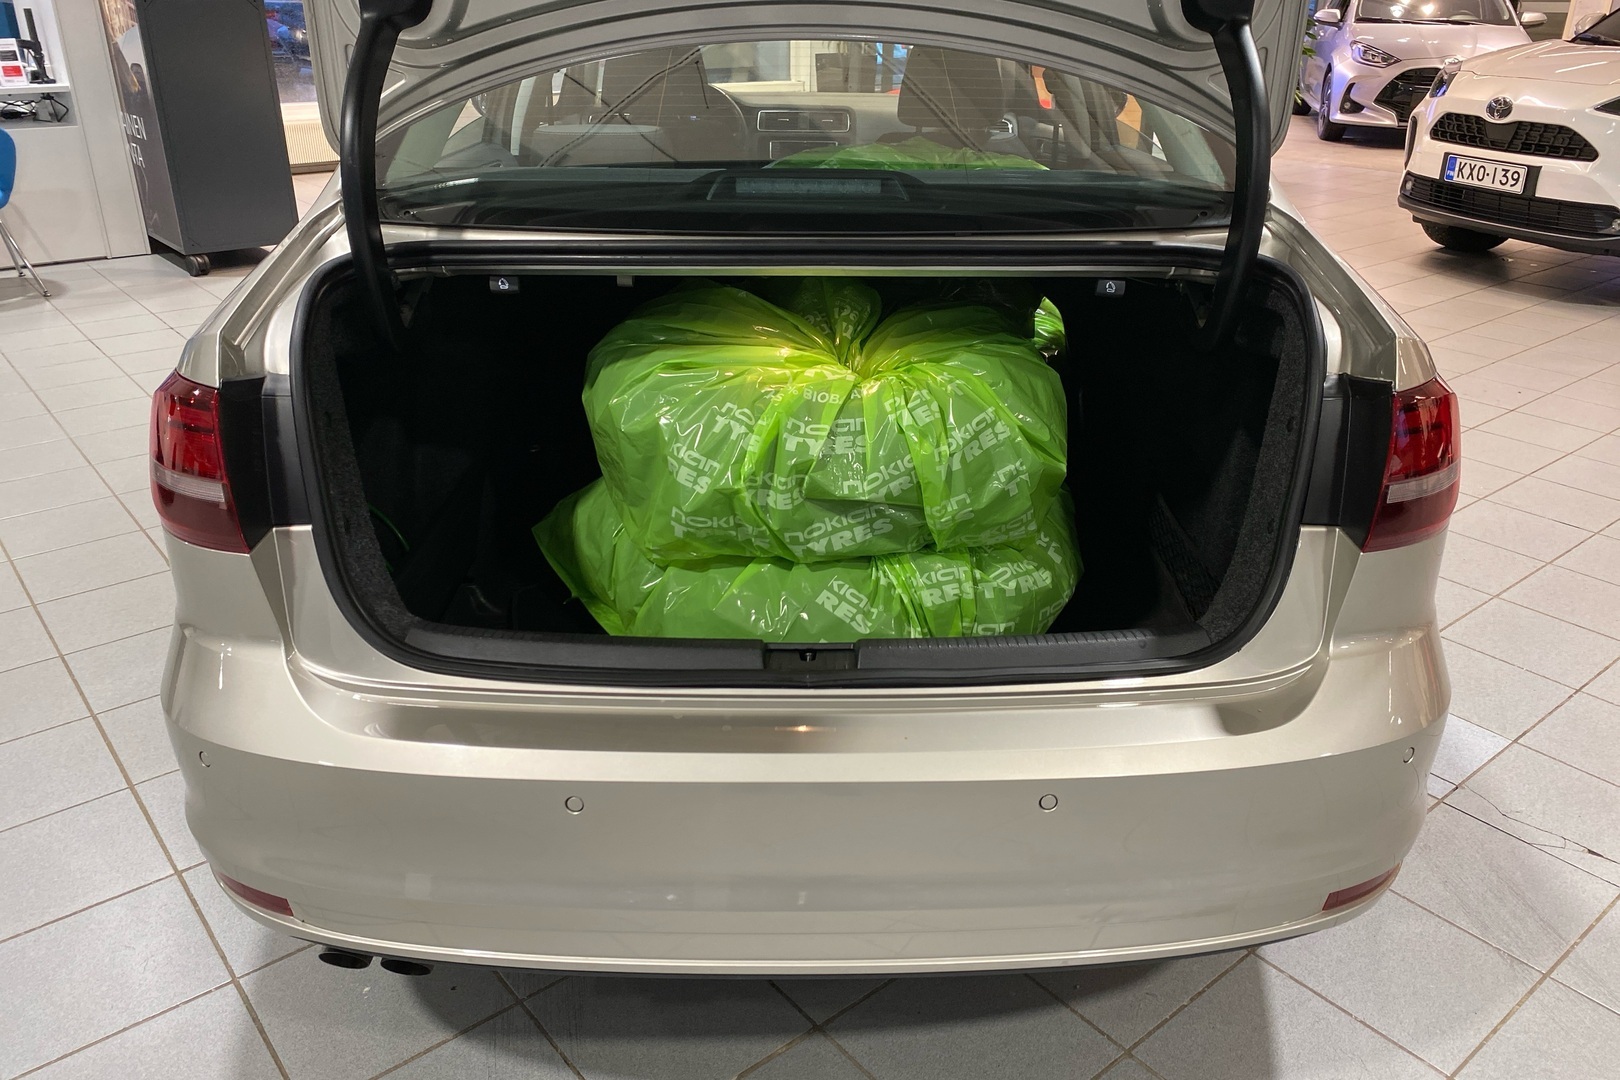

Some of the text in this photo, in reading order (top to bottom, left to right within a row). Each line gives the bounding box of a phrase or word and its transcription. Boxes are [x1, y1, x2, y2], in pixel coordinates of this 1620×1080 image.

[667, 456, 712, 495] RES
[787, 518, 894, 558] TYRES
[815, 589, 872, 635] RES
[920, 581, 974, 608] RES
